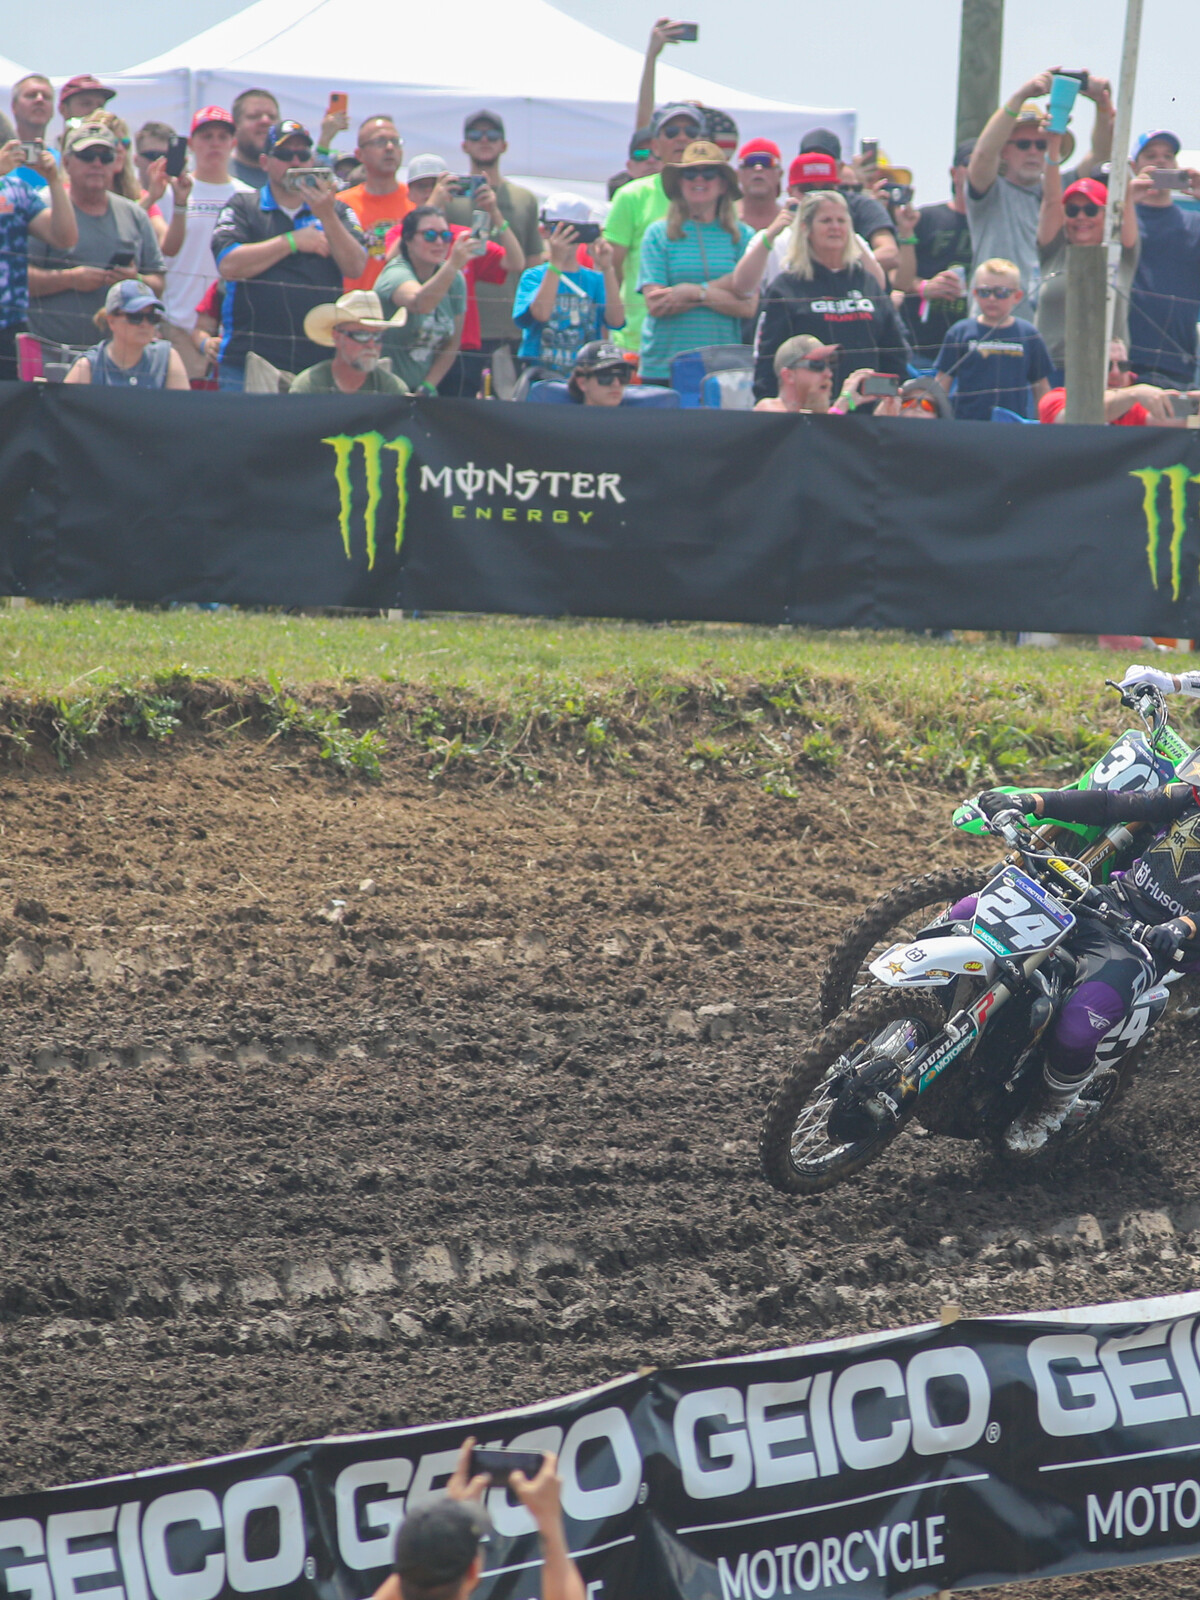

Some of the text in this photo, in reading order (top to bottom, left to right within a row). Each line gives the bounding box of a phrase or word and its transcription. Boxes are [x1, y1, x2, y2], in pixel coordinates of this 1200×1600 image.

[420, 462, 626, 504] MONSTER
[452, 505, 594, 524] ENERGY
[1093, 745, 1160, 792] 30
[977, 885, 1062, 950] 24
[918, 1022, 970, 1075] DUNLP
[934, 1032, 975, 1073] MOTOREX
[673, 1345, 991, 1500] GEICO
[0, 1474, 306, 1600] GEICO
[717, 1514, 946, 1600] MOTORCYCLE
